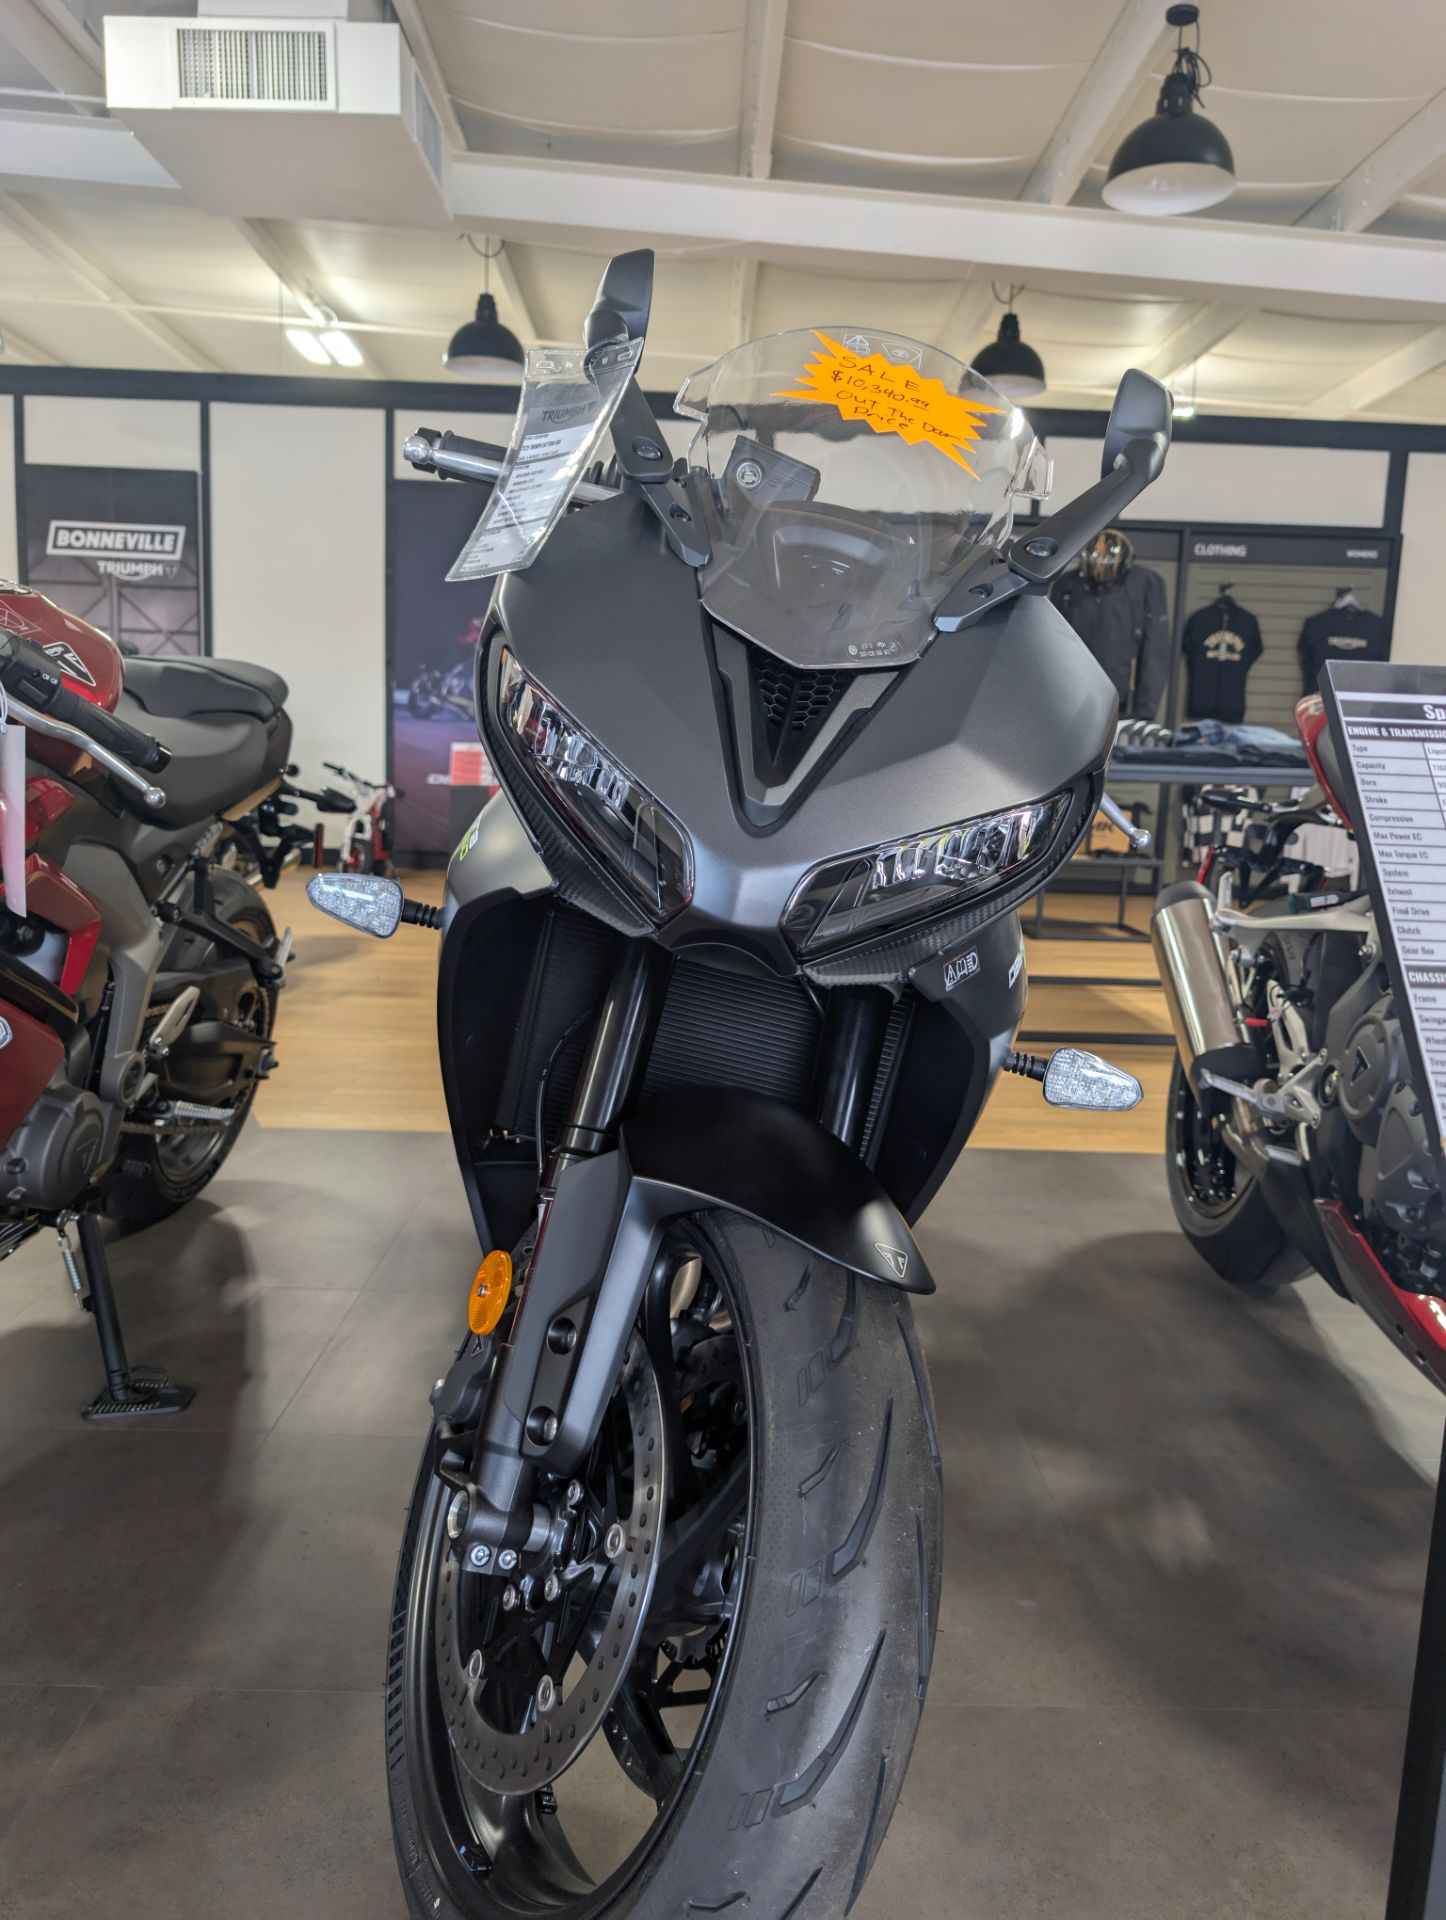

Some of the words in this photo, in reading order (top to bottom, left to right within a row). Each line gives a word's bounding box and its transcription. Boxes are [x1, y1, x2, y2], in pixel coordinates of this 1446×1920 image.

[838, 356, 921, 393] SALE
[830, 370, 930, 409] $10,340.99
[542, 404, 587, 424] TRIUMPH
[854, 406, 910, 430] Price
[55, 528, 176, 552] BONNEVILLE
[1193, 543, 1248, 558] CLOTHING
[96, 560, 164, 581] TRIUMPH
[1422, 703, 1446, 721] Sp
[1347, 725, 1380, 737] ENGINE
[1380, 727, 1389, 737] &
[1352, 744, 1368, 752] Type
[1356, 761, 1386, 771] Capacity
[1360, 778, 1377, 786] Bore
[1364, 795, 1388, 804] Stroke
[1369, 813, 1414, 823] Compression
[1373, 831, 1388, 840] Max
[1389, 832, 1411, 841] Power
[1378, 849, 1393, 858] Max
[1394, 850, 1418, 860] Torque
[1382, 868, 1409, 878] System
[1387, 887, 1413, 896] Exhaust
[1392, 906, 1410, 915] Final
[1410, 906, 1430, 916] Drive
[1397, 925, 1421, 935] Clutch
[1401, 945, 1419, 955] Gear
[1420, 946, 1435, 955] Box
